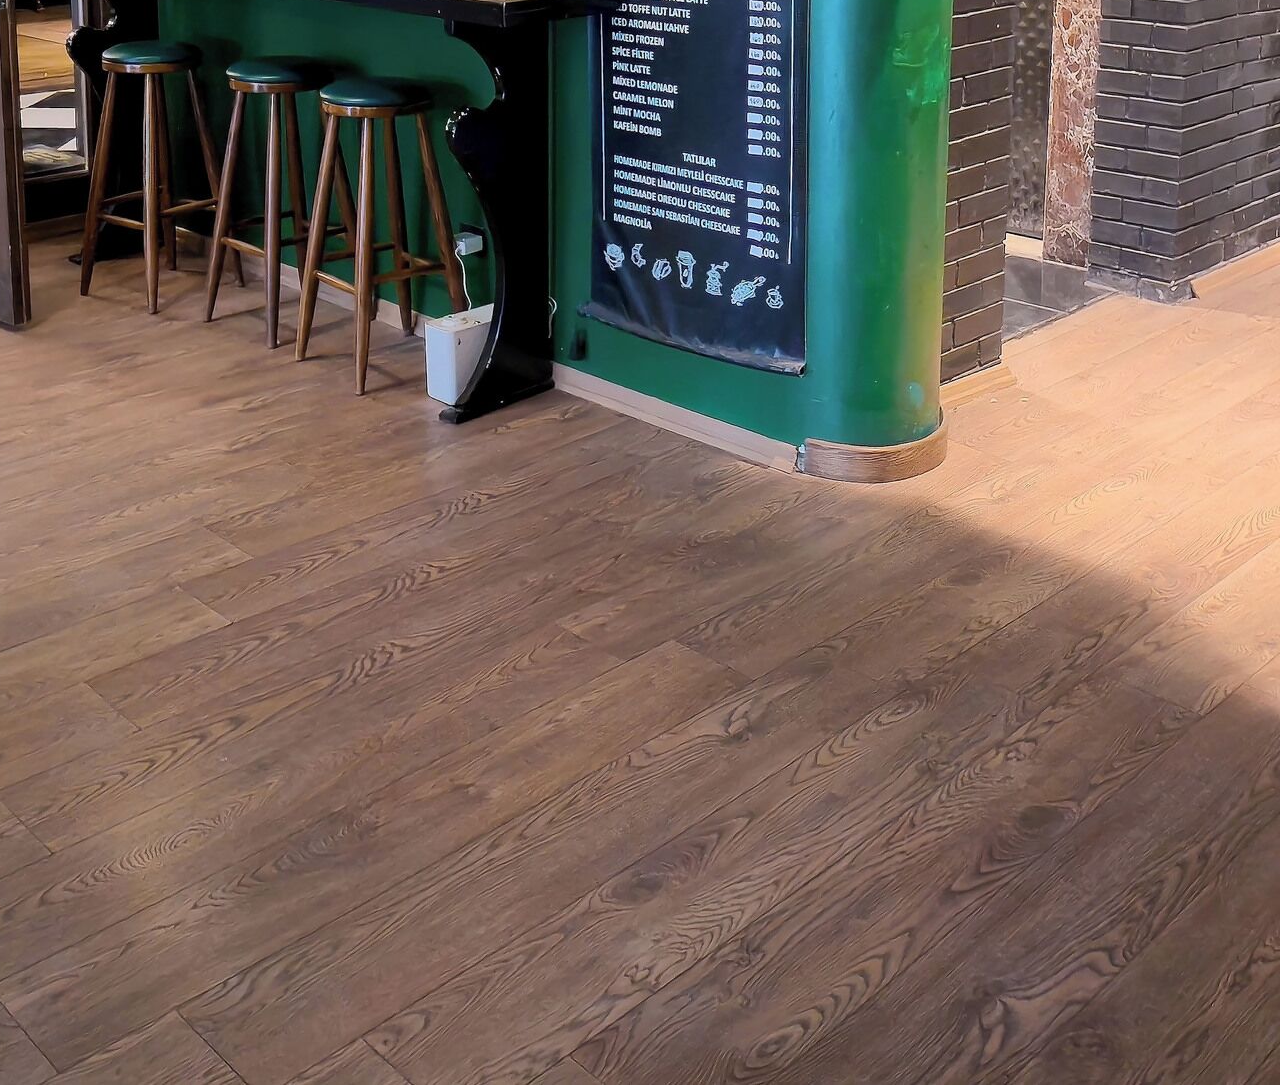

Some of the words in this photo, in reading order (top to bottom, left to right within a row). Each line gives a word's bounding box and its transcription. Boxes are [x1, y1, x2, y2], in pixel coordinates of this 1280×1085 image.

[629, 4, 651, 15] TOFFE
[651, 6, 668, 16] NUT
[669, 7, 691, 19] LATTE
[611, 17, 627, 27] ICED
[628, 19, 663, 31] AROMALI
[664, 22, 690, 34] KAHVE
[611, 30, 635, 43] MİXED
[635, 34, 665, 47] FROZEN
[612, 46, 631, 57] SPİCE
[631, 47, 655, 61] FİLTRE
[612, 60, 630, 72] PİNK
[630, 64, 651, 75] LATTE
[612, 75, 636, 88] MİXED
[637, 79, 679, 94] LEMONADE
[613, 90, 647, 105] CARAMEL
[647, 96, 675, 109] MELON
[613, 104, 632, 116] MİNT
[633, 108, 661, 122] MOCHA
[613, 120, 638, 134] KAFEİN
[639, 124, 662, 137] BOMB
[682, 153, 716, 168] TATLILAR
[613, 154, 651, 170] HOMEMADE
[652, 162, 676, 176] KIRMIZI
[705, 173, 744, 190] CHESSCAKE
[613, 169, 656, 186] HOMEMADE
[657, 177, 691, 193] LİMONLU
[692, 185, 736, 203] CHESSCAKE
[613, 184, 657, 201] HOMEMADE
[657, 193, 687, 208] OREOLU
[688, 200, 731, 218] CHESSCAKE
[613, 199, 651, 215] HOMEMADE
[652, 207, 665, 219] SAN
[665, 210, 701, 227] SEBASTİAN
[701, 219, 741, 235] CHEESCAKE
[613, 213, 652, 230] MAGNOLİA
